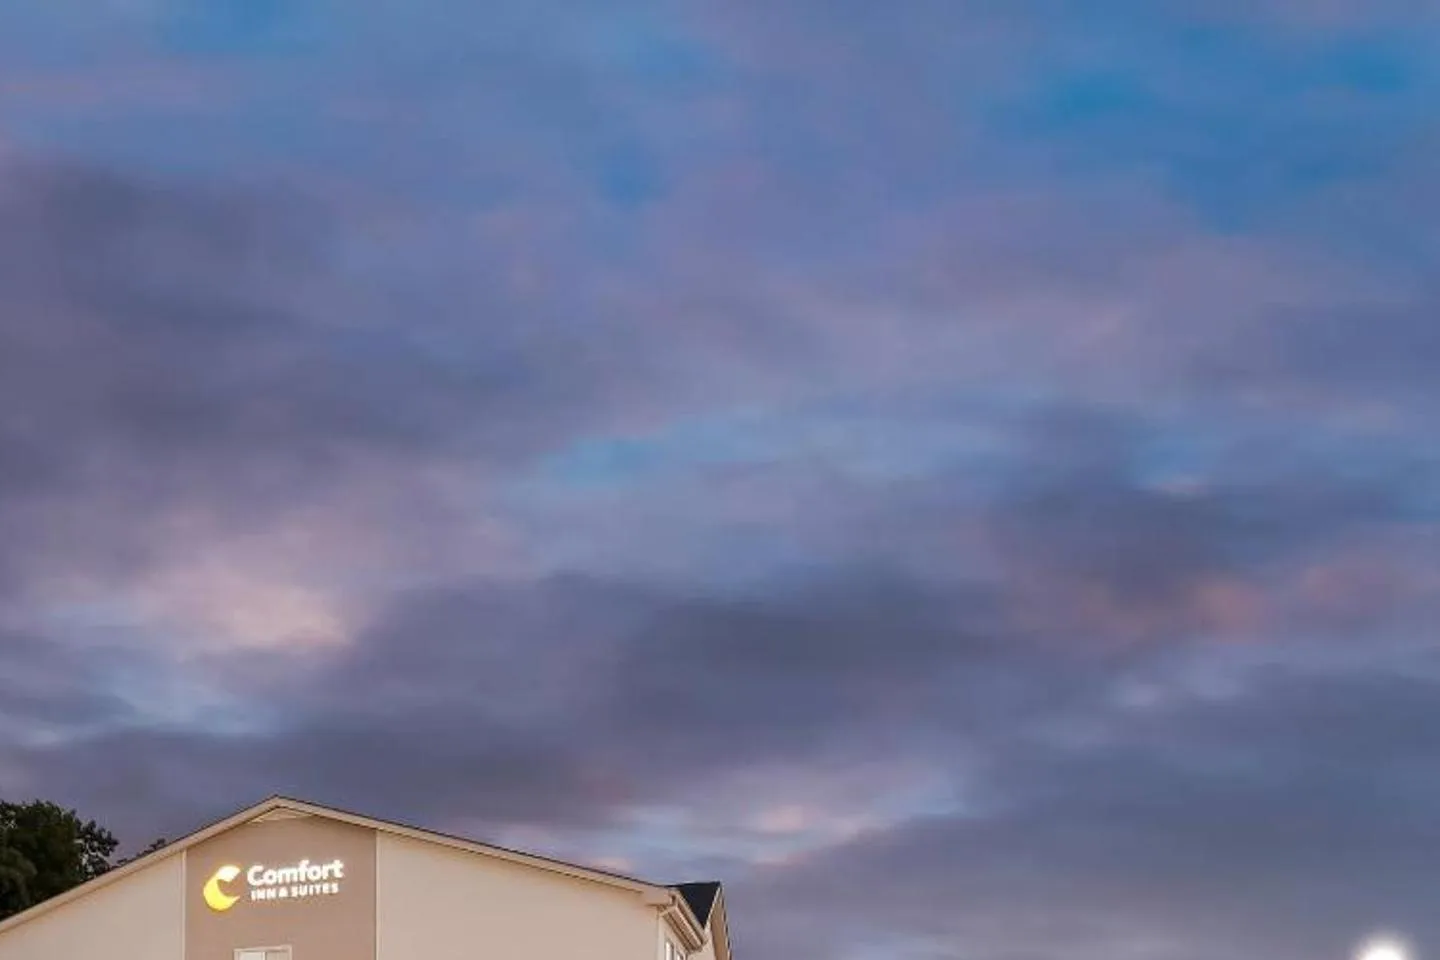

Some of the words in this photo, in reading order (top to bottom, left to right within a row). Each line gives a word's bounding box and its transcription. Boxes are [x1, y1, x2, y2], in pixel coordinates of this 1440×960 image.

[247, 859, 344, 886] Comfort
[251, 888, 276, 900] INN
[291, 882, 339, 897] SUITES
